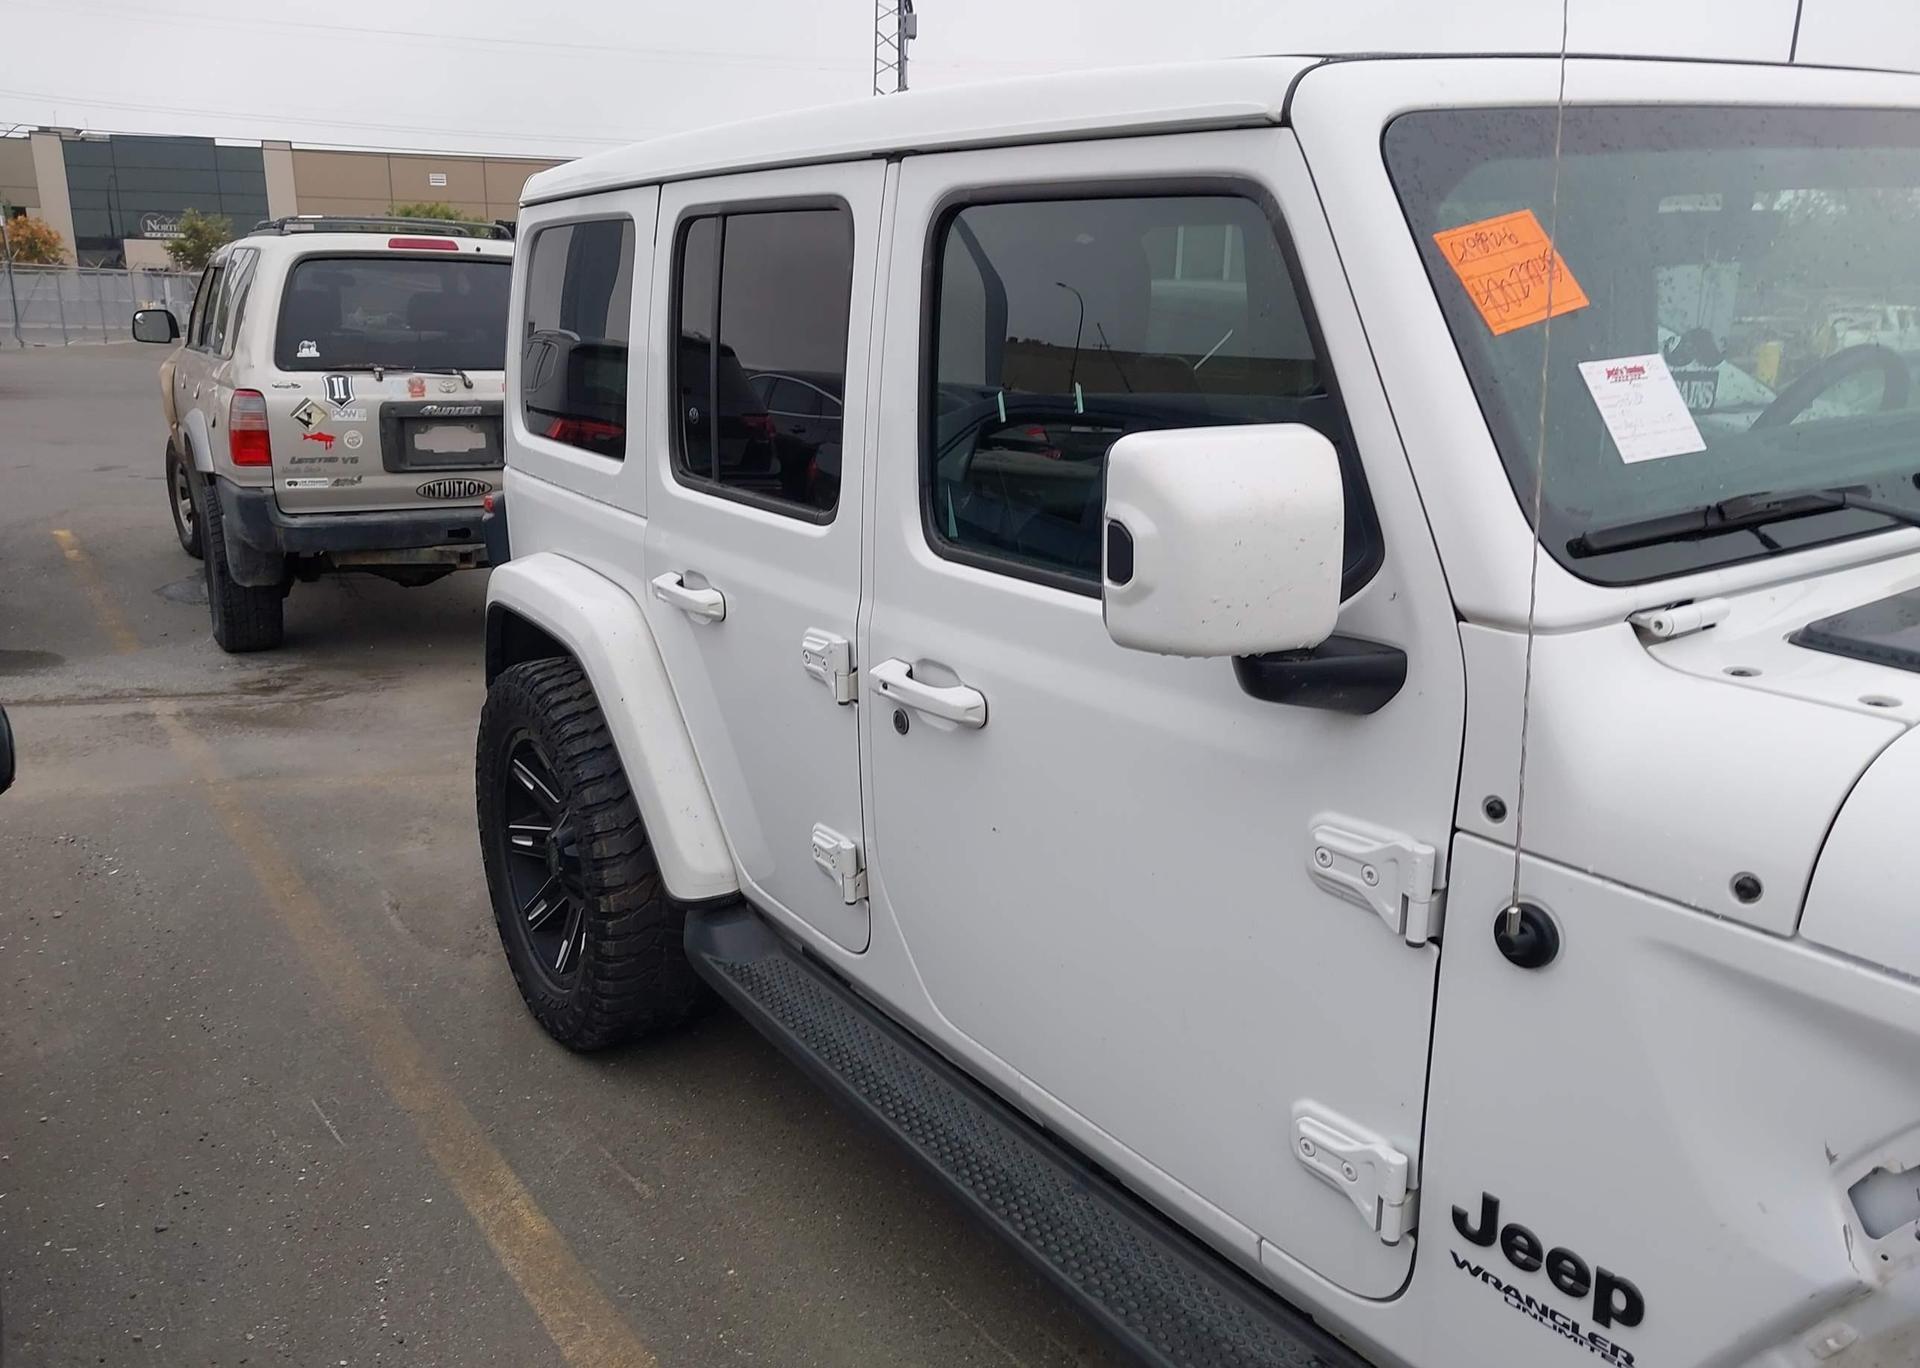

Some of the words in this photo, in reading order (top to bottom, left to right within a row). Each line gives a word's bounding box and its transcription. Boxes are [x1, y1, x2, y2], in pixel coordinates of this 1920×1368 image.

[341, 456, 359, 465] V6
[423, 480, 486, 498] INTUITION
[1452, 1190, 1646, 1329] Jeep
[1450, 1248, 1636, 1366] WRANGLER
